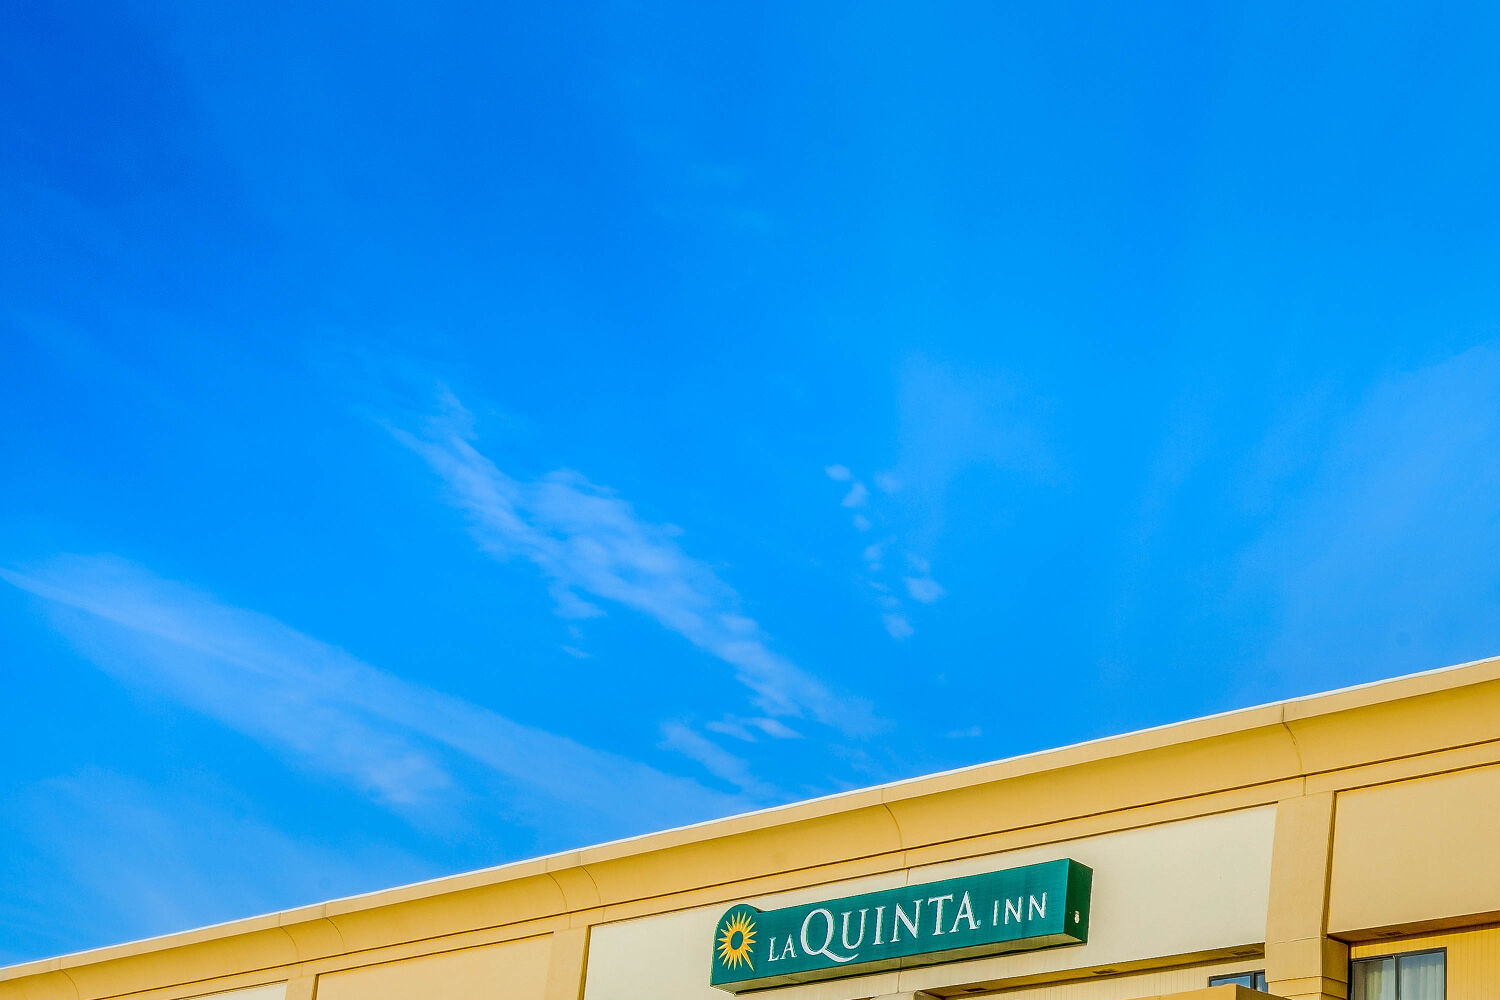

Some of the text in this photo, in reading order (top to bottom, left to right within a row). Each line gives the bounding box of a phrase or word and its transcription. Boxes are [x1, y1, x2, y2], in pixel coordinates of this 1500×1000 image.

[768, 891, 1047, 962] LA QUINTA INN
